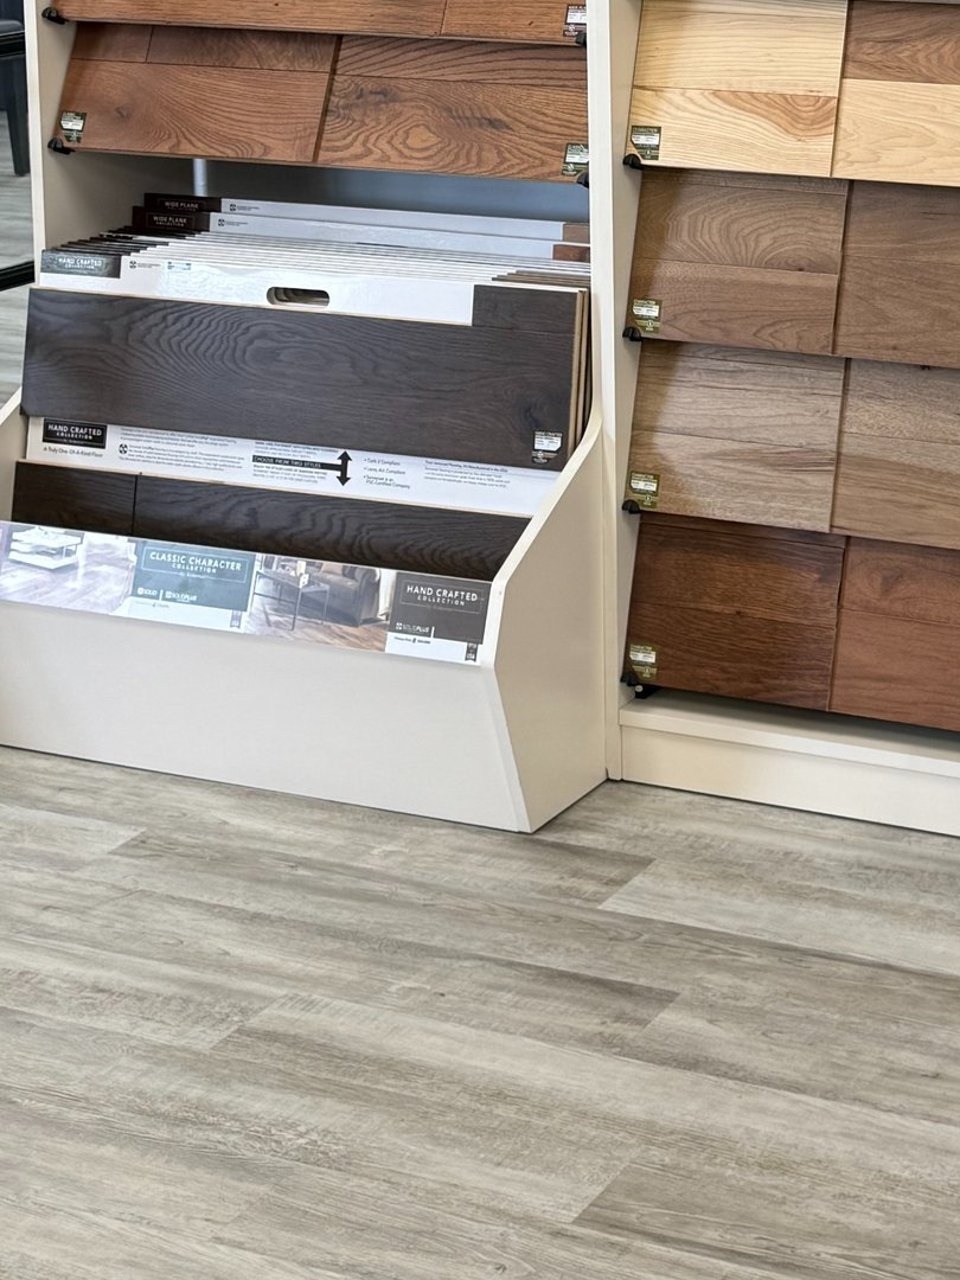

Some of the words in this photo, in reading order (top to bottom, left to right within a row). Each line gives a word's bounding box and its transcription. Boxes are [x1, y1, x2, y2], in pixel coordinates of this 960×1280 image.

[48, 424, 68, 433] HAND
[70, 426, 102, 436] CRAFTED
[56, 431, 93, 440] COLLECTION
[149, 551, 186, 564] CLASSIC
[188, 556, 242, 571] CHARACTER
[172, 562, 217, 573] COLLECTION
[407, 585, 433, 596] HAND
[436, 588, 478, 601] CRAFTED
[417, 595, 465, 606] COLLECTION
